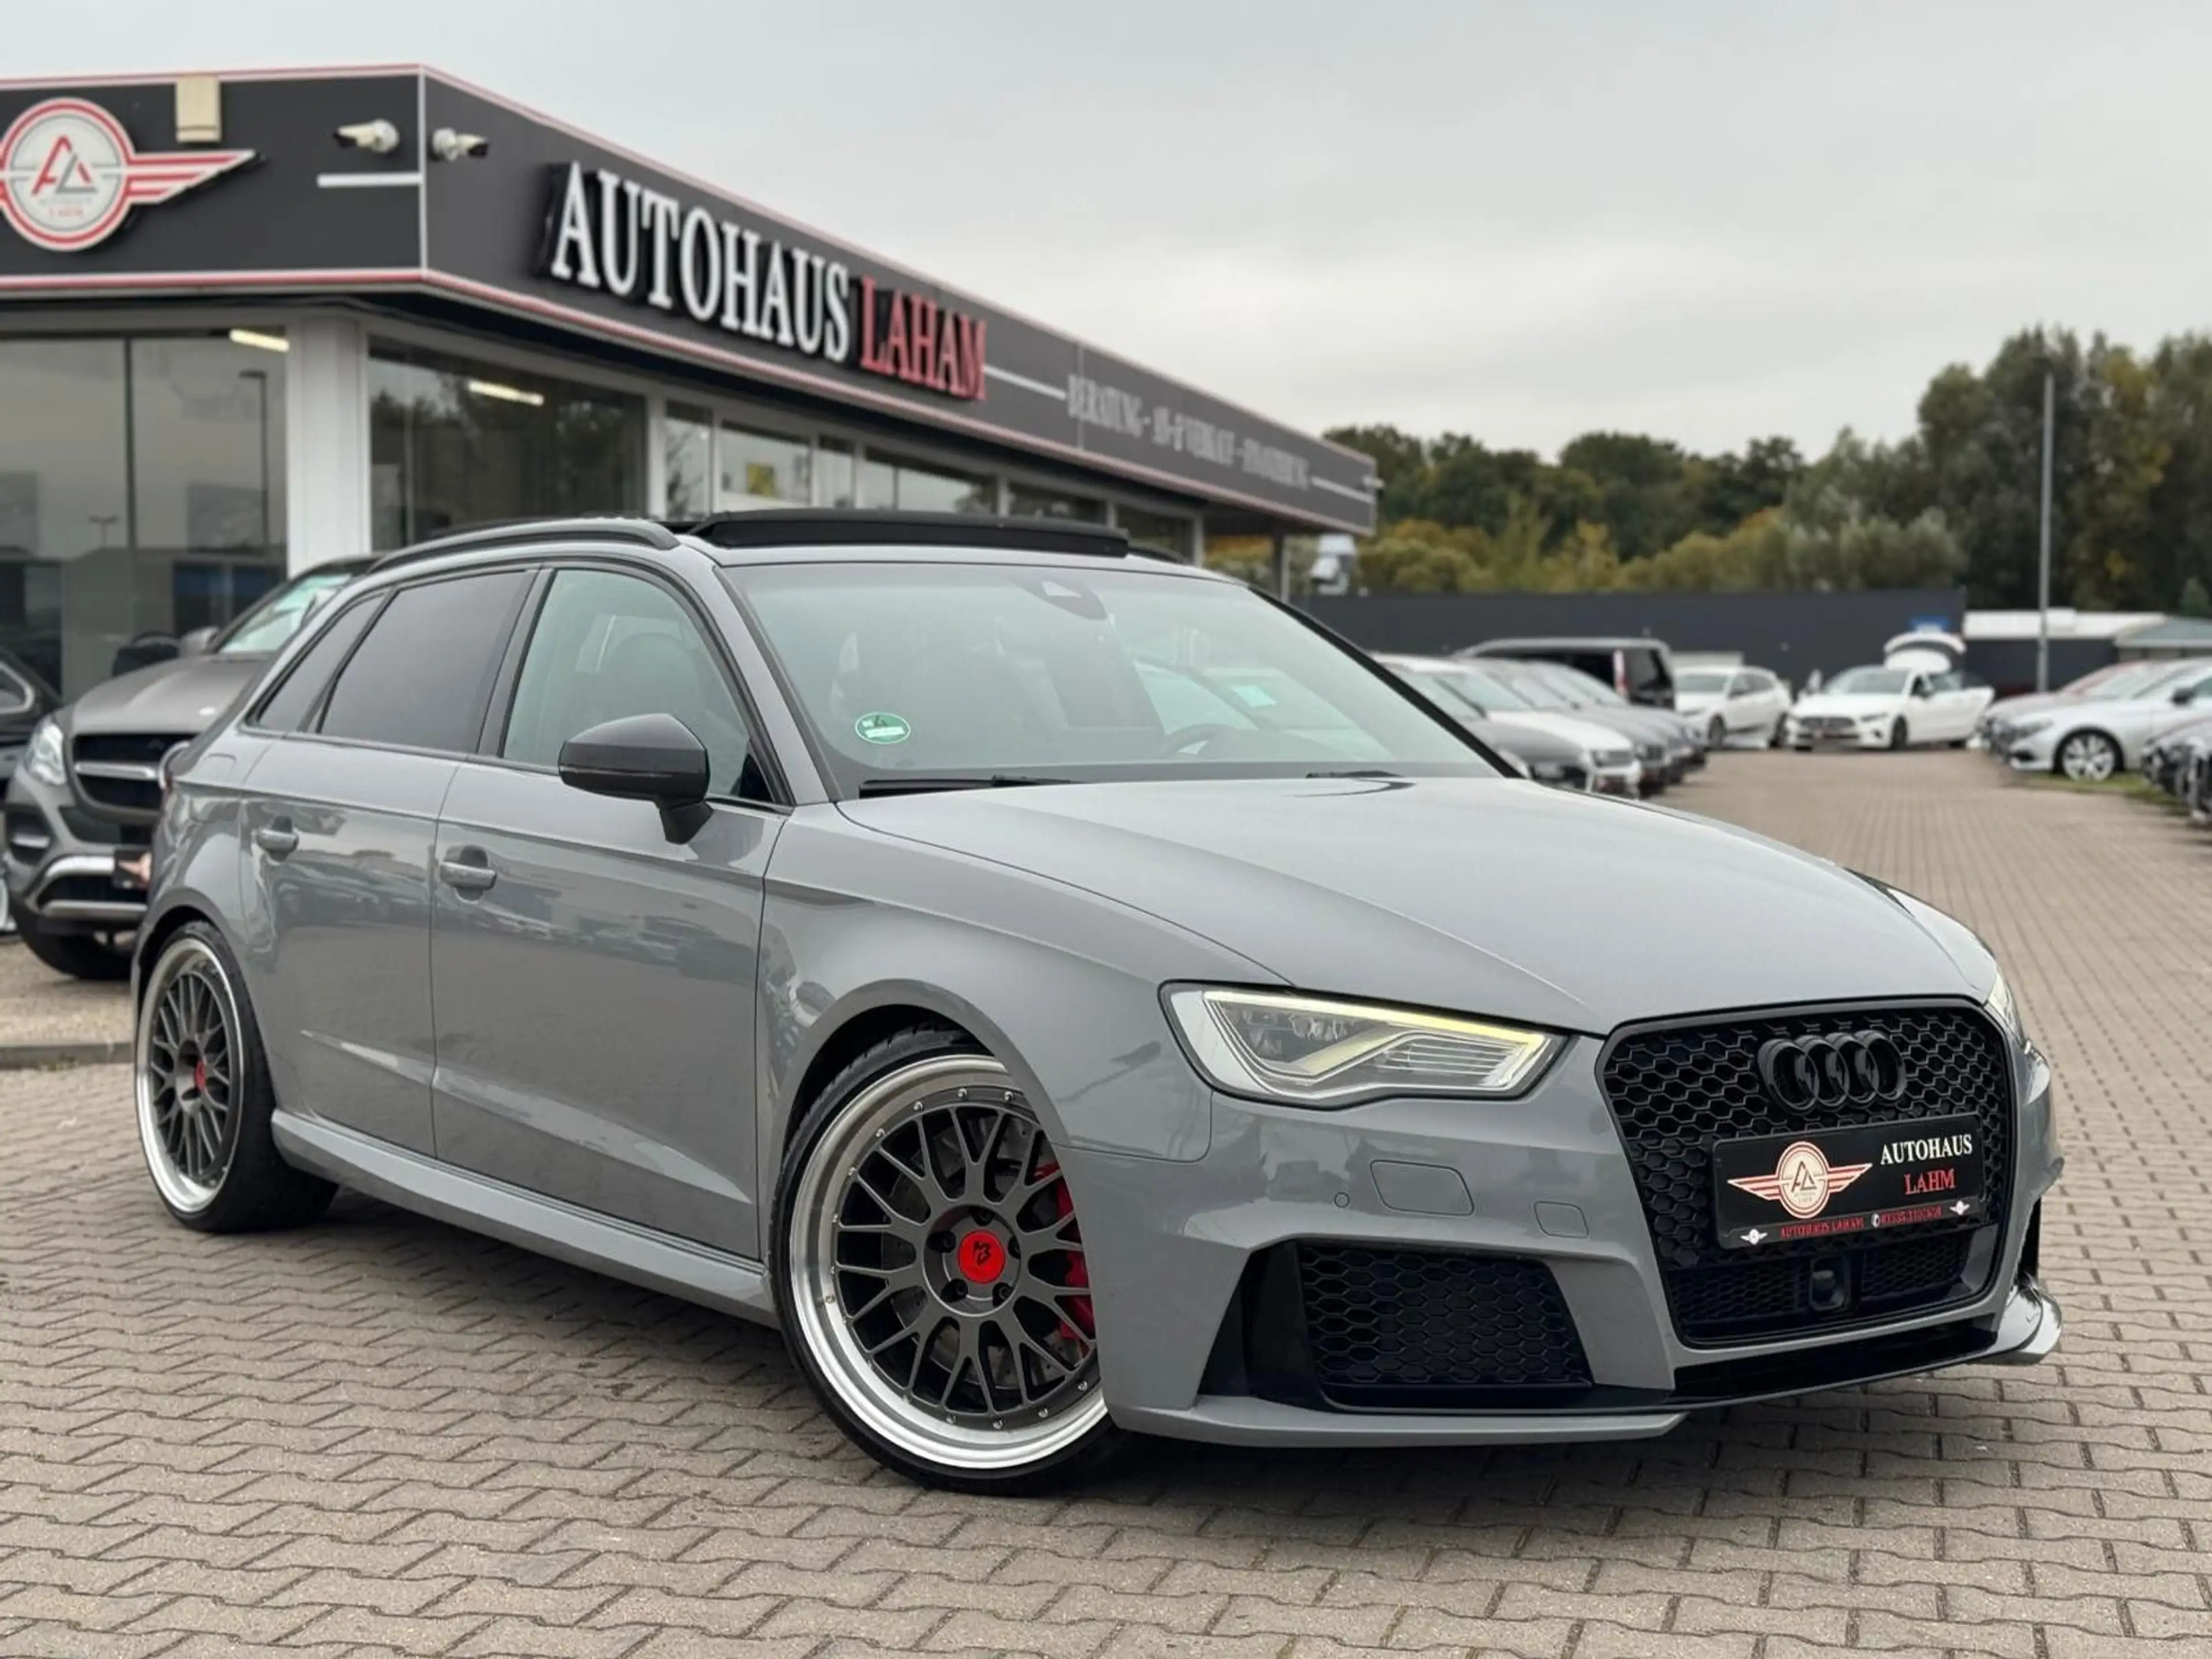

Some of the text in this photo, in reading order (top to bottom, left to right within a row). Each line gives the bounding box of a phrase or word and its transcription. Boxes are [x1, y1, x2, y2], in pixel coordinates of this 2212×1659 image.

[551, 161, 988, 400] AUTOHAUS LAHAM
[1880, 1134, 1972, 1165] AUTOHAUS
[1904, 1168, 1956, 1195] LAHM
